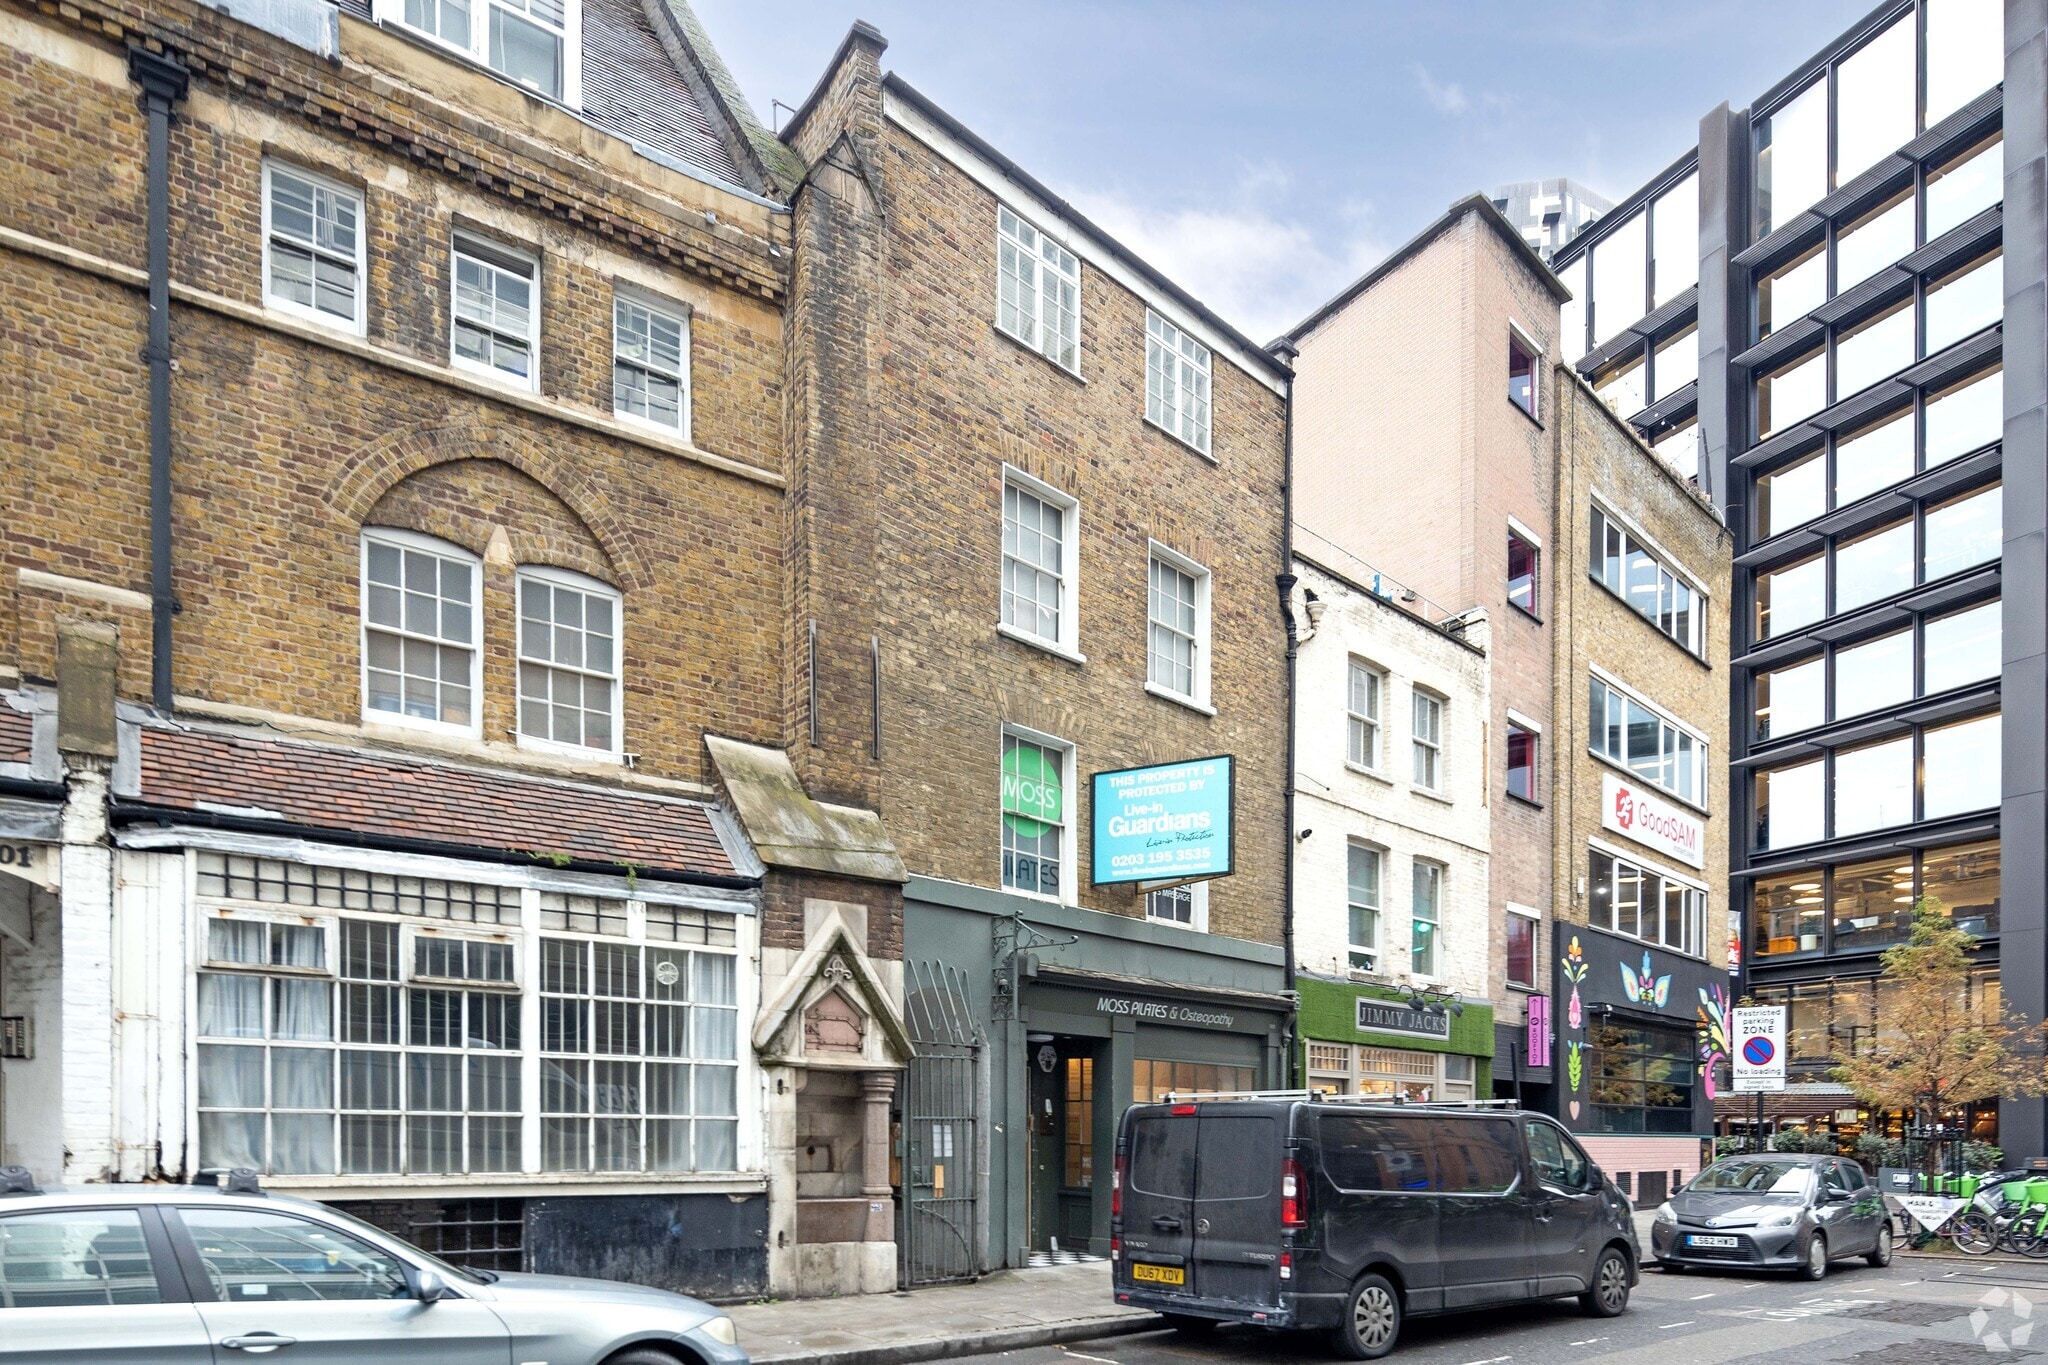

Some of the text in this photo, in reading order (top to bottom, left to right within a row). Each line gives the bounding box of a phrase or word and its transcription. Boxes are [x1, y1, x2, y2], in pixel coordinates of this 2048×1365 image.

[1109, 765, 1215, 788] THIS PROPERTY IS
[1003, 775, 1055, 809] MOSS
[1119, 779, 1206, 799] PROTECTED BY
[1124, 801, 1163, 816] Live-in
[1108, 811, 1211, 837] Guardians
[1639, 802, 1695, 851] GoodSAM
[1111, 846, 1211, 867] 0203 195 3535
[1004, 854, 1059, 887] ILATES
[1096, 997, 1234, 1028] MOSS PILATES & Osteopathy
[1360, 1007, 1446, 1032] JIMMY JACKS
[1737, 1009, 1781, 1017] Restricted
[1743, 1026, 1774, 1034] ZONE
[1751, 1068, 1781, 1076] loading
[1138, 1266, 1180, 1282] DU67 XDV
